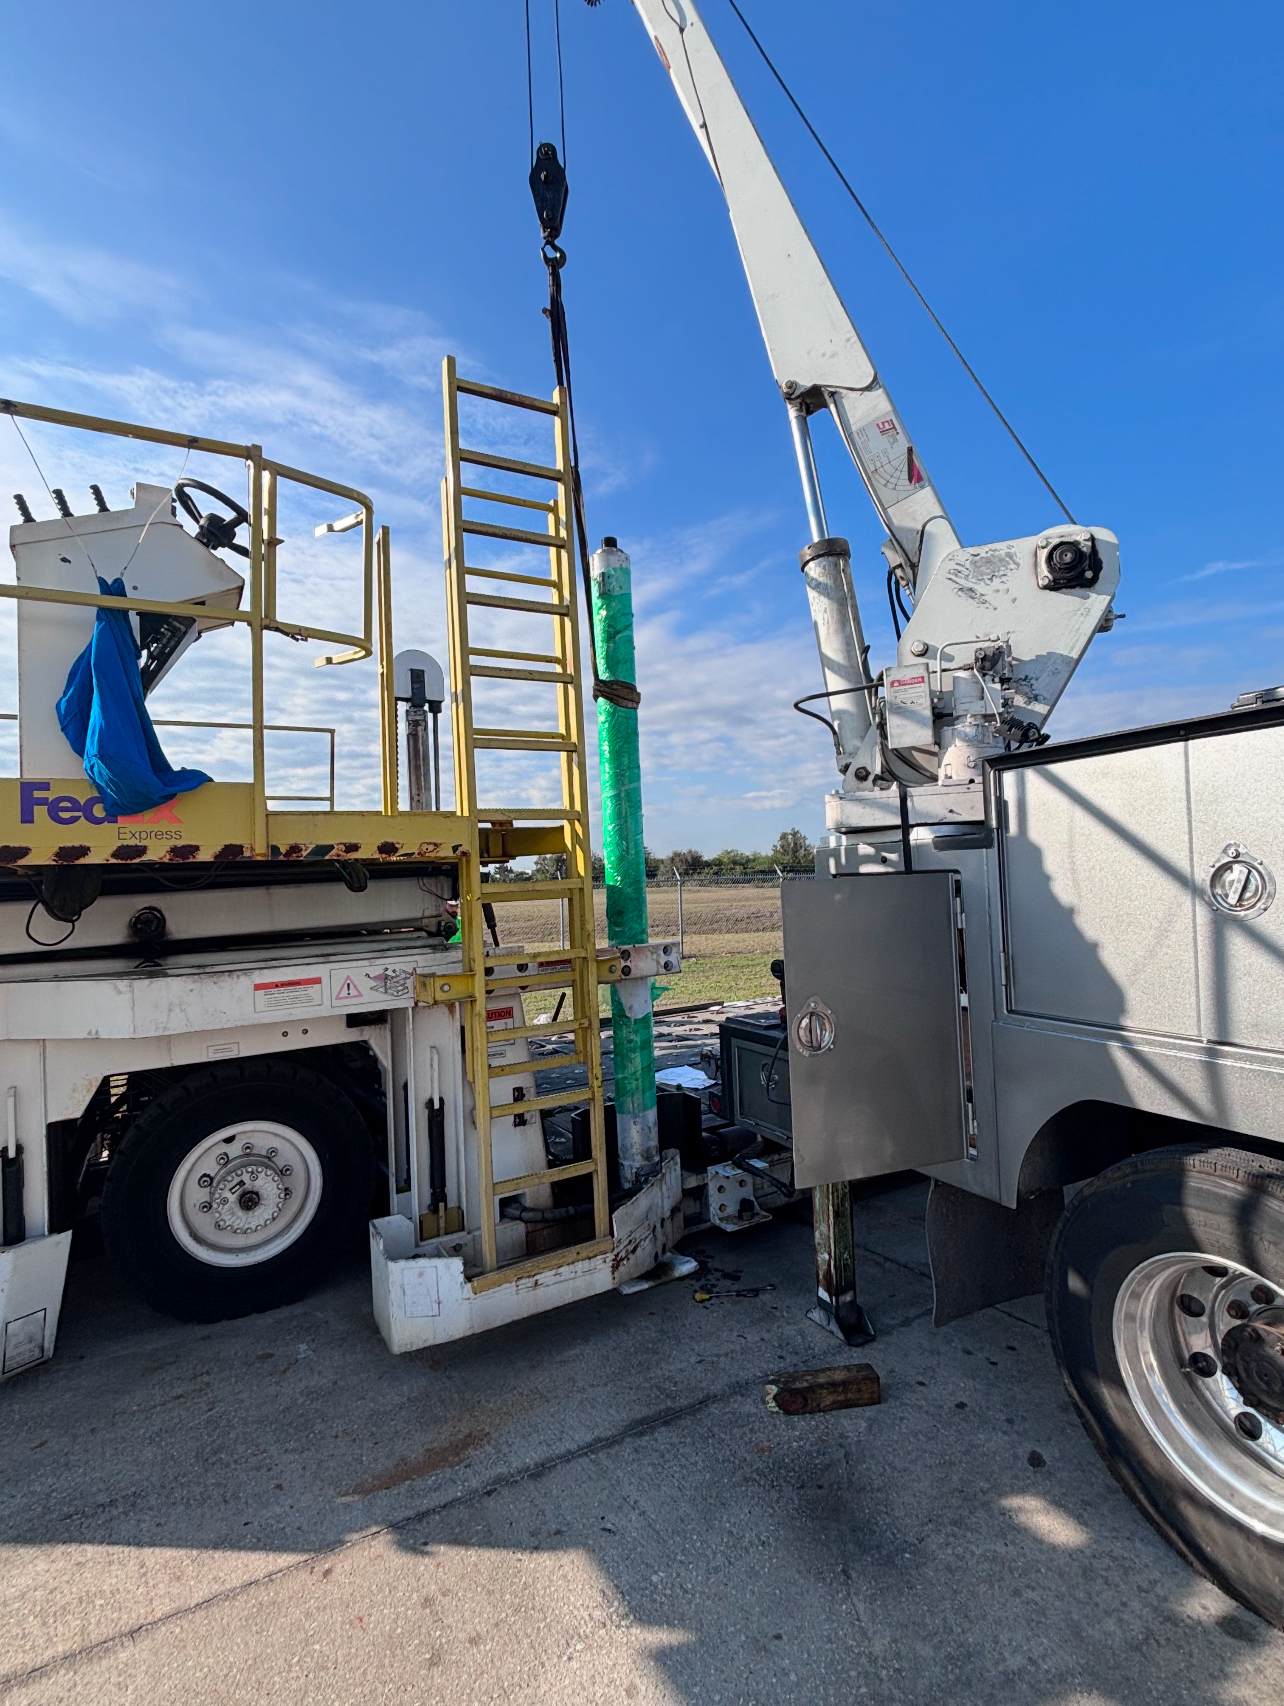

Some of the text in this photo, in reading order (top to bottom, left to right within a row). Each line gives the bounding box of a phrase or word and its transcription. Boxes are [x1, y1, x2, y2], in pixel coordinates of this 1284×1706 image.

[20, 781, 183, 825] Fex
[117, 826, 183, 842] Express
[487, 1010, 511, 1019] UTION
